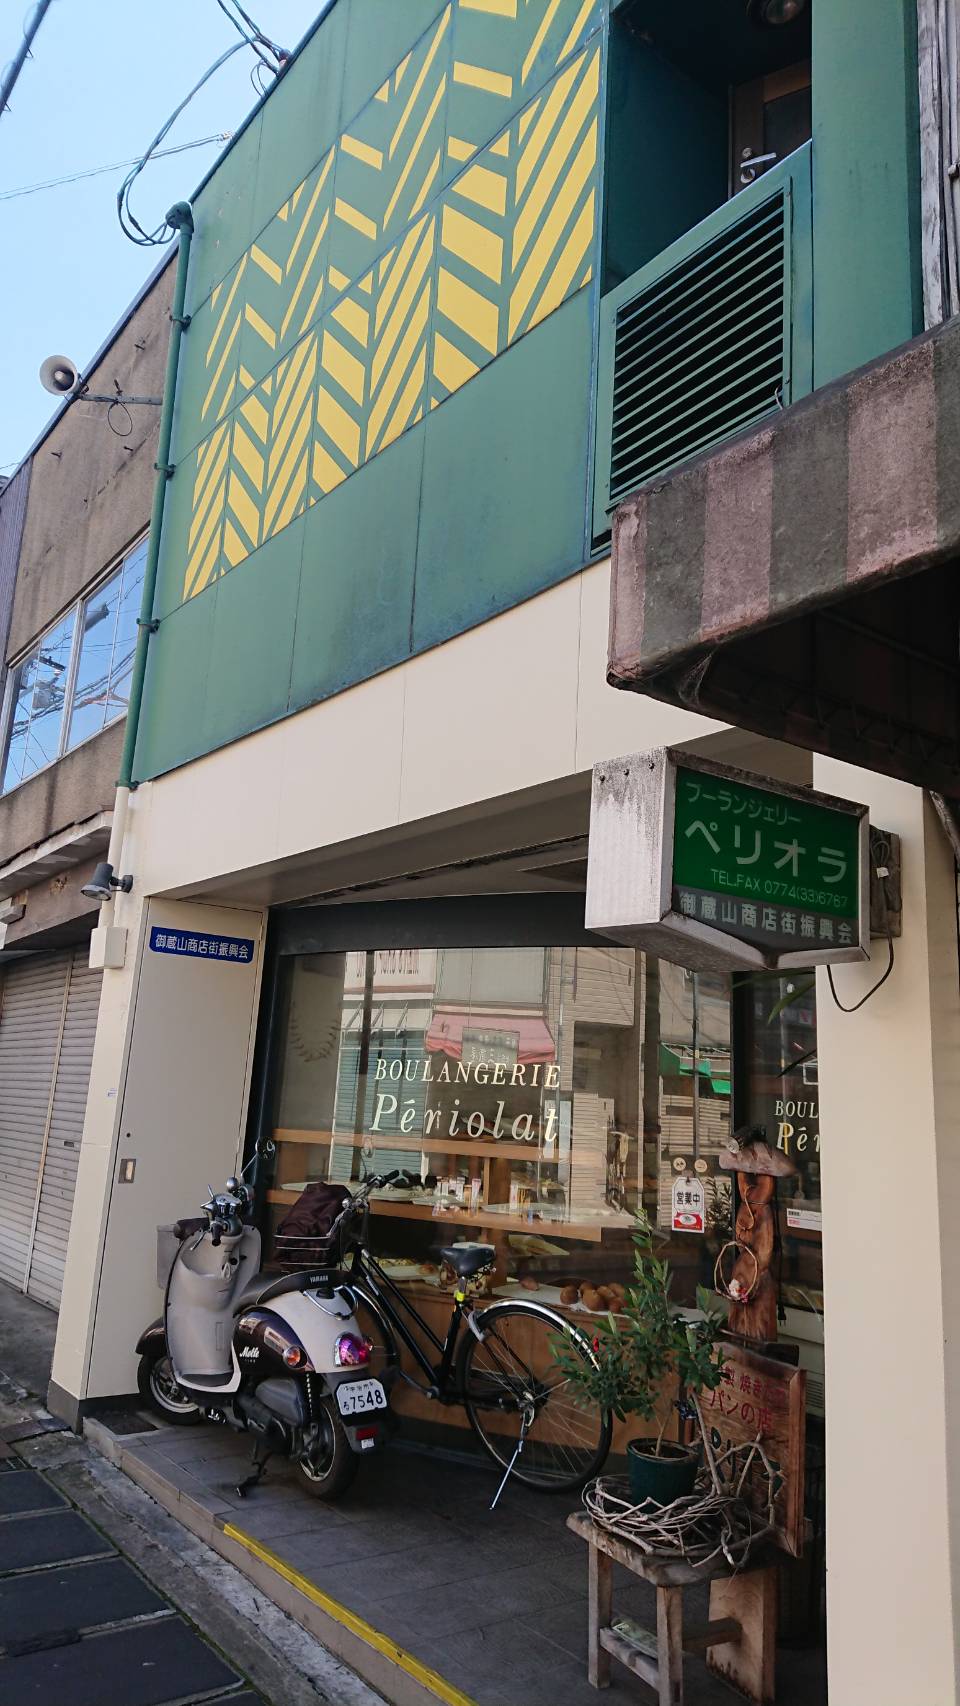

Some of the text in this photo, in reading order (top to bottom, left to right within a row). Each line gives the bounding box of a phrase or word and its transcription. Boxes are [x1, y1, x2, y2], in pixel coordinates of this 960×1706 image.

[684, 819, 849, 883] ペリオラ
[710, 868, 761, 893] TEL.FAX
[680, 891, 853, 945] 御蔵山商店街振興会
[155, 933, 249, 960] 御蔵山商店街振興会
[374, 1058, 561, 1088] BOULANGERIE
[368, 1093, 559, 1142] Périolat
[774, 1100, 819, 1119] BOUL
[676, 1191, 701, 1206] 営業中
[310, 1275, 329, 1284] YAMAHA
[350, 1389, 383, 1409] 7548
[710, 1389, 774, 1434] パンの店
